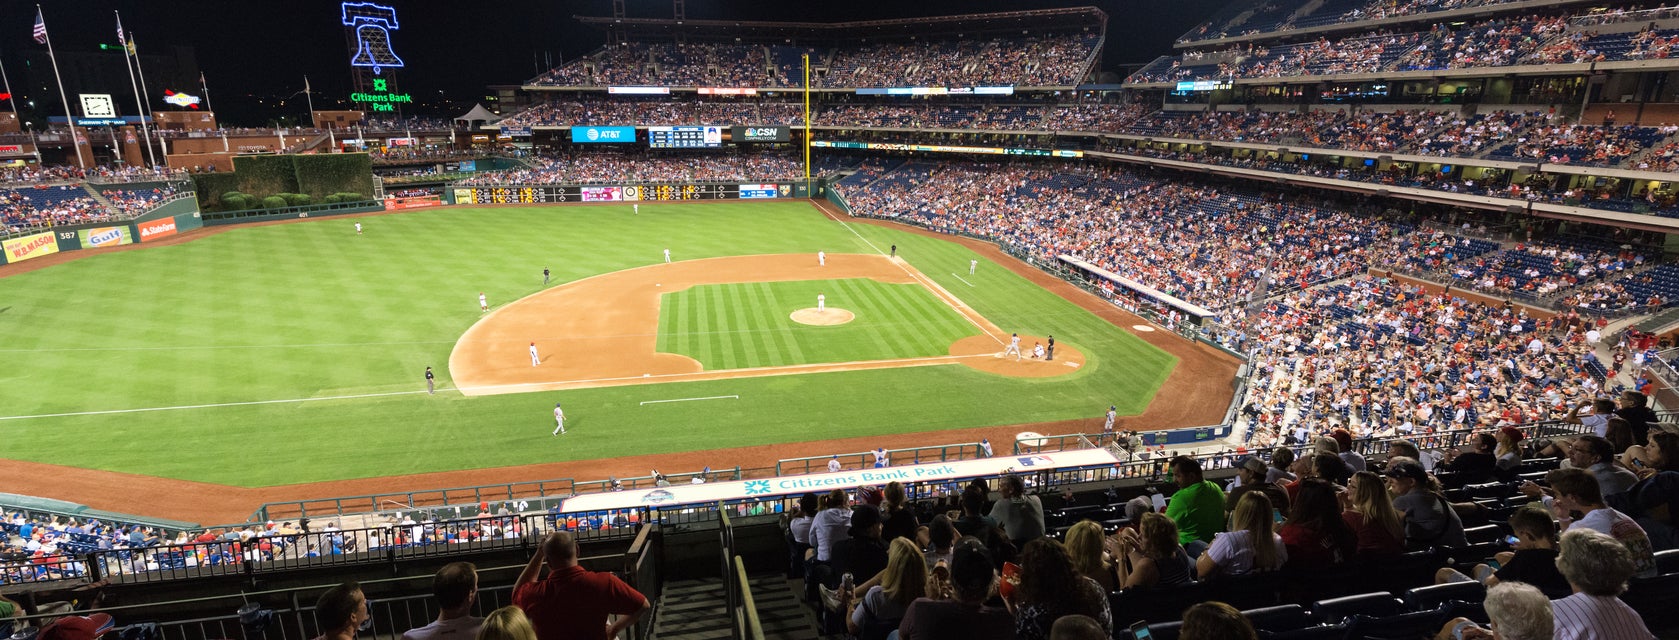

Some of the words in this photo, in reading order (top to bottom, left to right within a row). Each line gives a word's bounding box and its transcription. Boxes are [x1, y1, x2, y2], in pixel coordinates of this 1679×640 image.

[351, 92, 388, 101] Citizens
[389, 93, 411, 101] Bank
[373, 103, 393, 111] Park
[90, 230, 120, 244] Gulf
[779, 475, 857, 489] Citizens
[861, 469, 910, 482] Bank
[914, 464, 957, 477] Park
